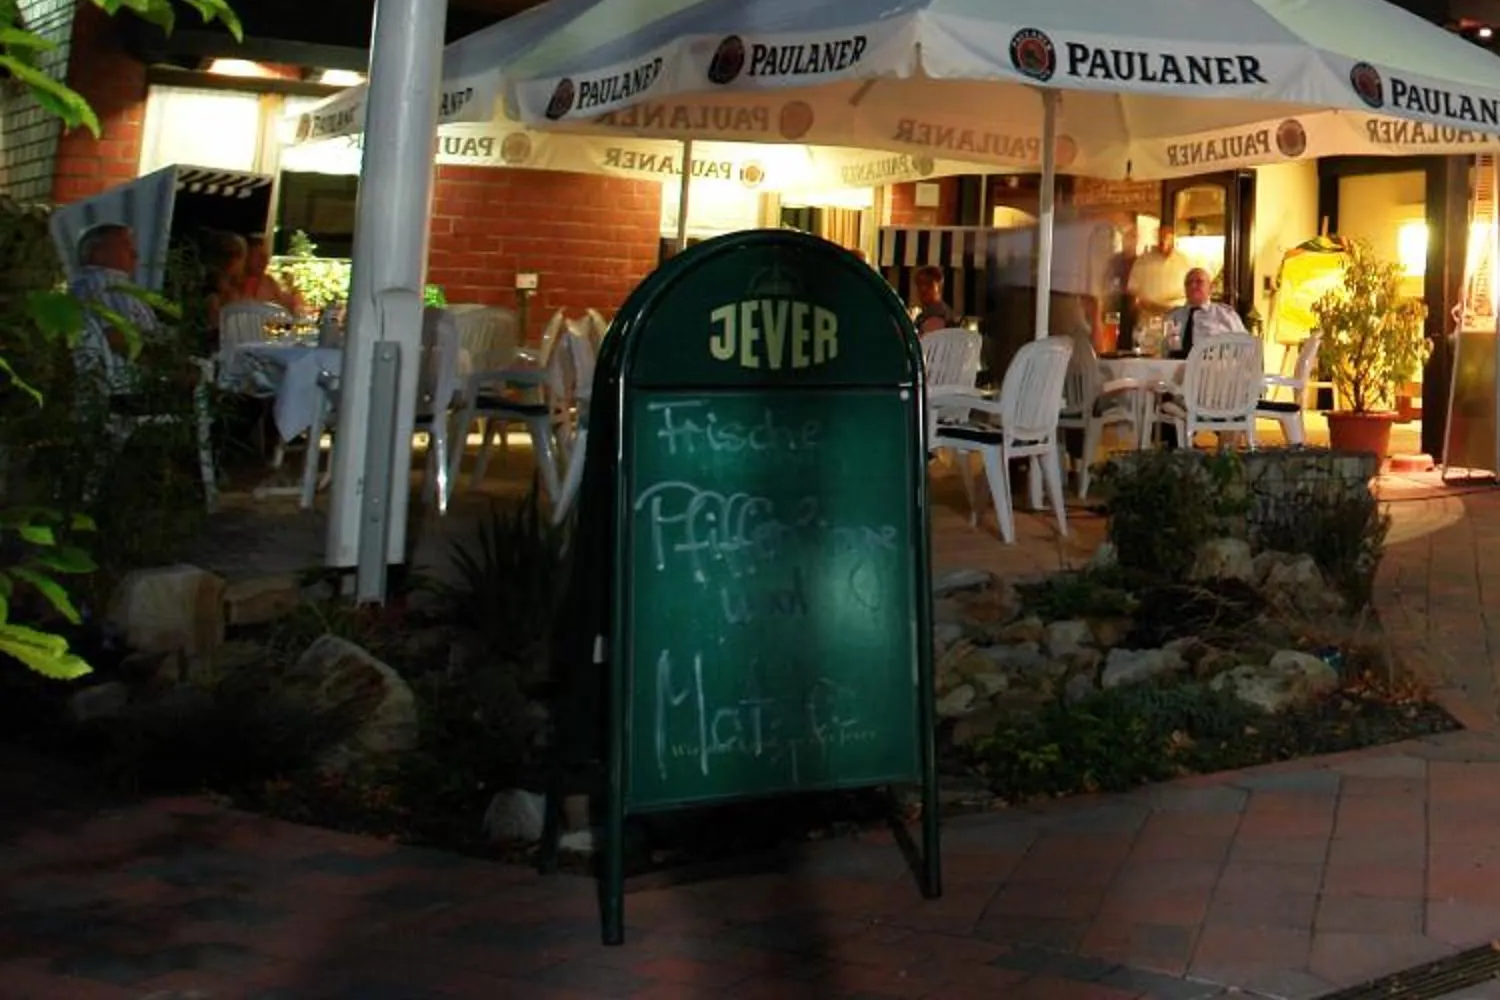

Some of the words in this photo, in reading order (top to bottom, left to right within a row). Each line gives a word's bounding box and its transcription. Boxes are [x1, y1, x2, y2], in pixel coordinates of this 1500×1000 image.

[748, 36, 867, 76] PAULANER
[1065, 42, 1269, 85] PAULANER
[710, 299, 838, 370] JEVER
[646, 397, 824, 456] Frische
